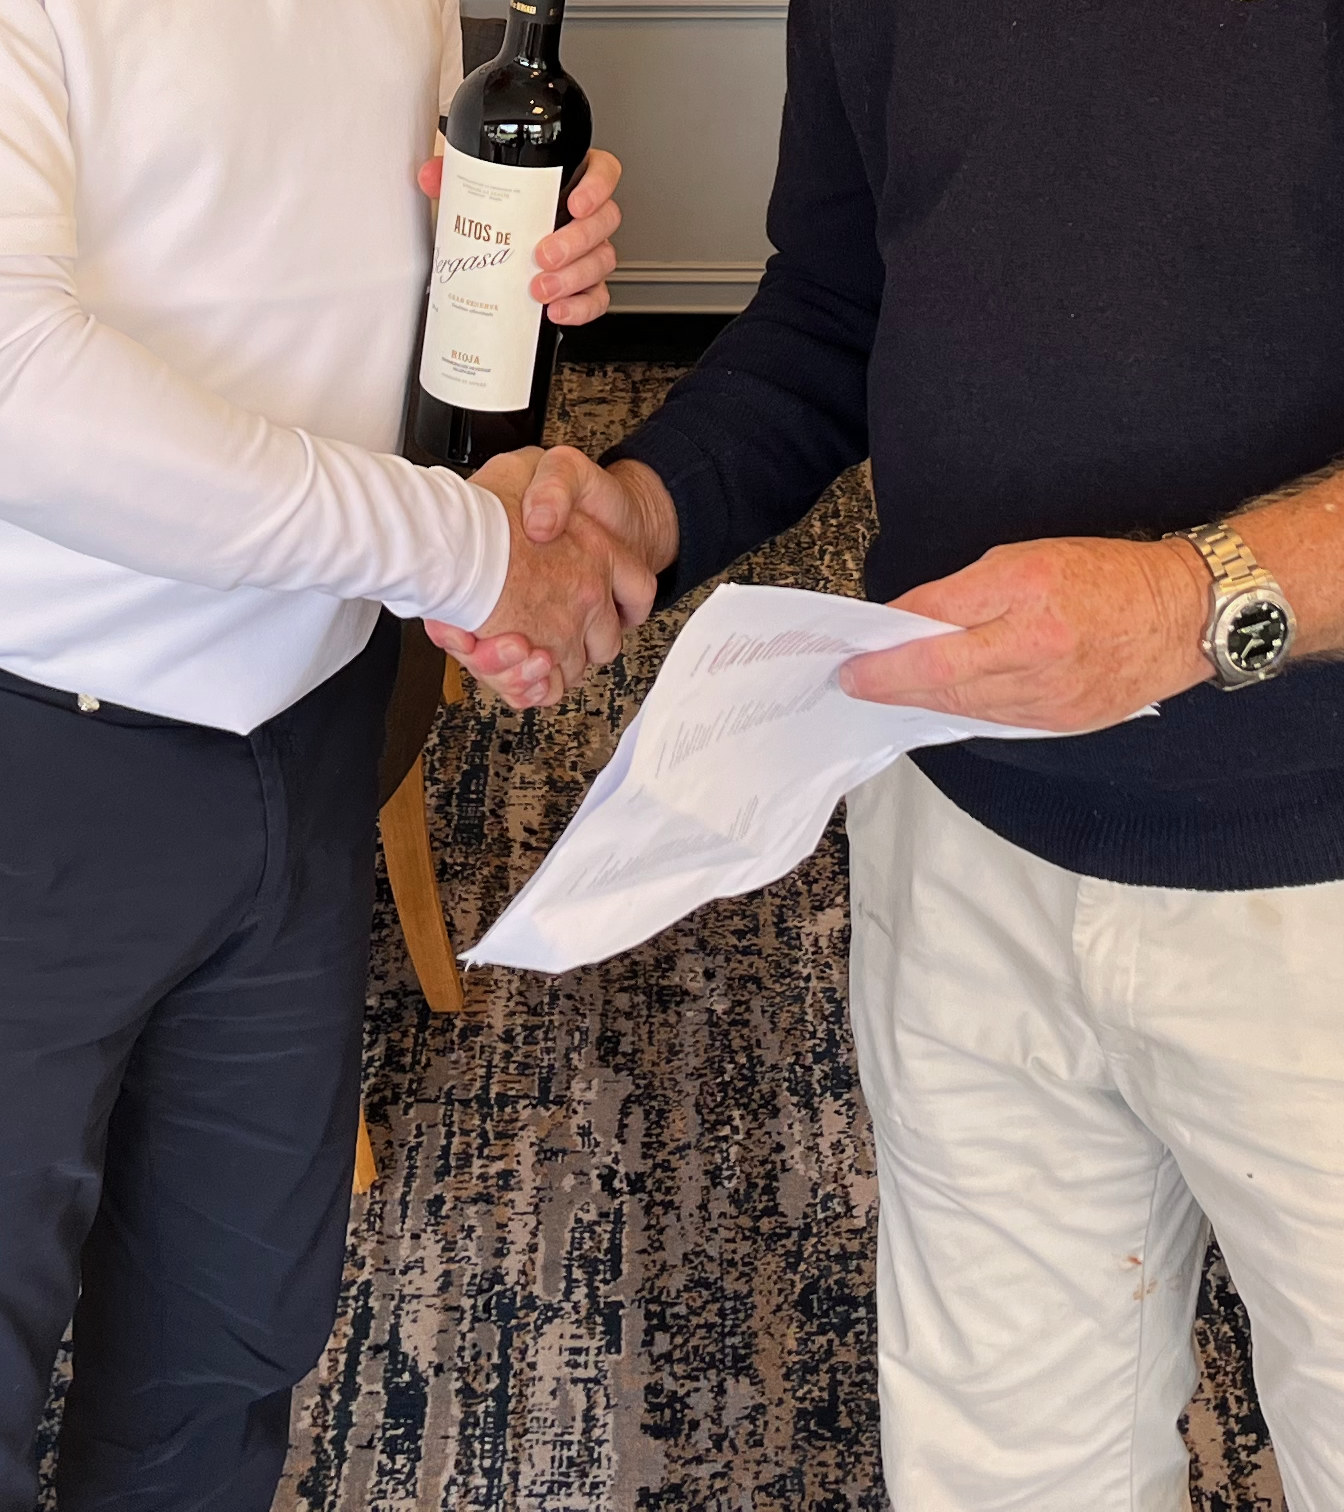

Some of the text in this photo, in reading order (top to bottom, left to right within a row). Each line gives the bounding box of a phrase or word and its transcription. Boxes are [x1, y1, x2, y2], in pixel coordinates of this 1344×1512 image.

[454, 214, 512, 245] ALTOS DE
[451, 349, 481, 365] RIOJA
